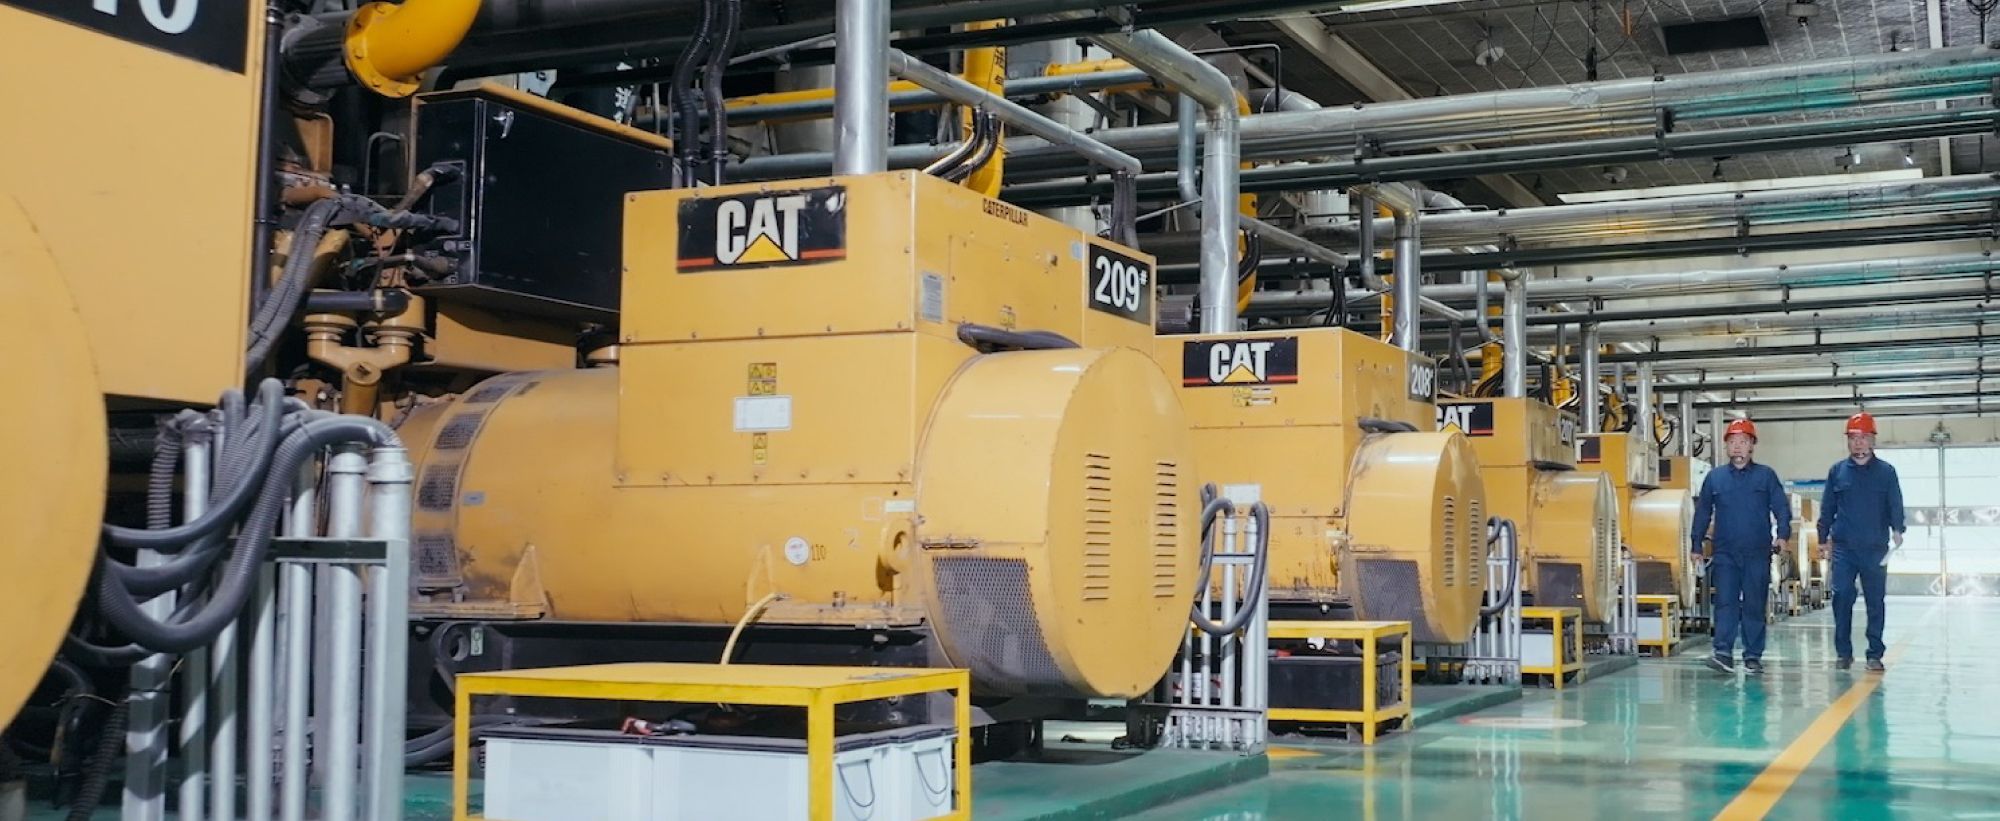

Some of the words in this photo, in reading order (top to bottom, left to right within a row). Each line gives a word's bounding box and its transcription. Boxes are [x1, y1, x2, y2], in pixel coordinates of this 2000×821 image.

[716, 195, 806, 264] CAT
[983, 198, 1028, 227] CATERPILLAR
[1095, 255, 1148, 312] 209#
[1209, 342, 1270, 383] CAT
